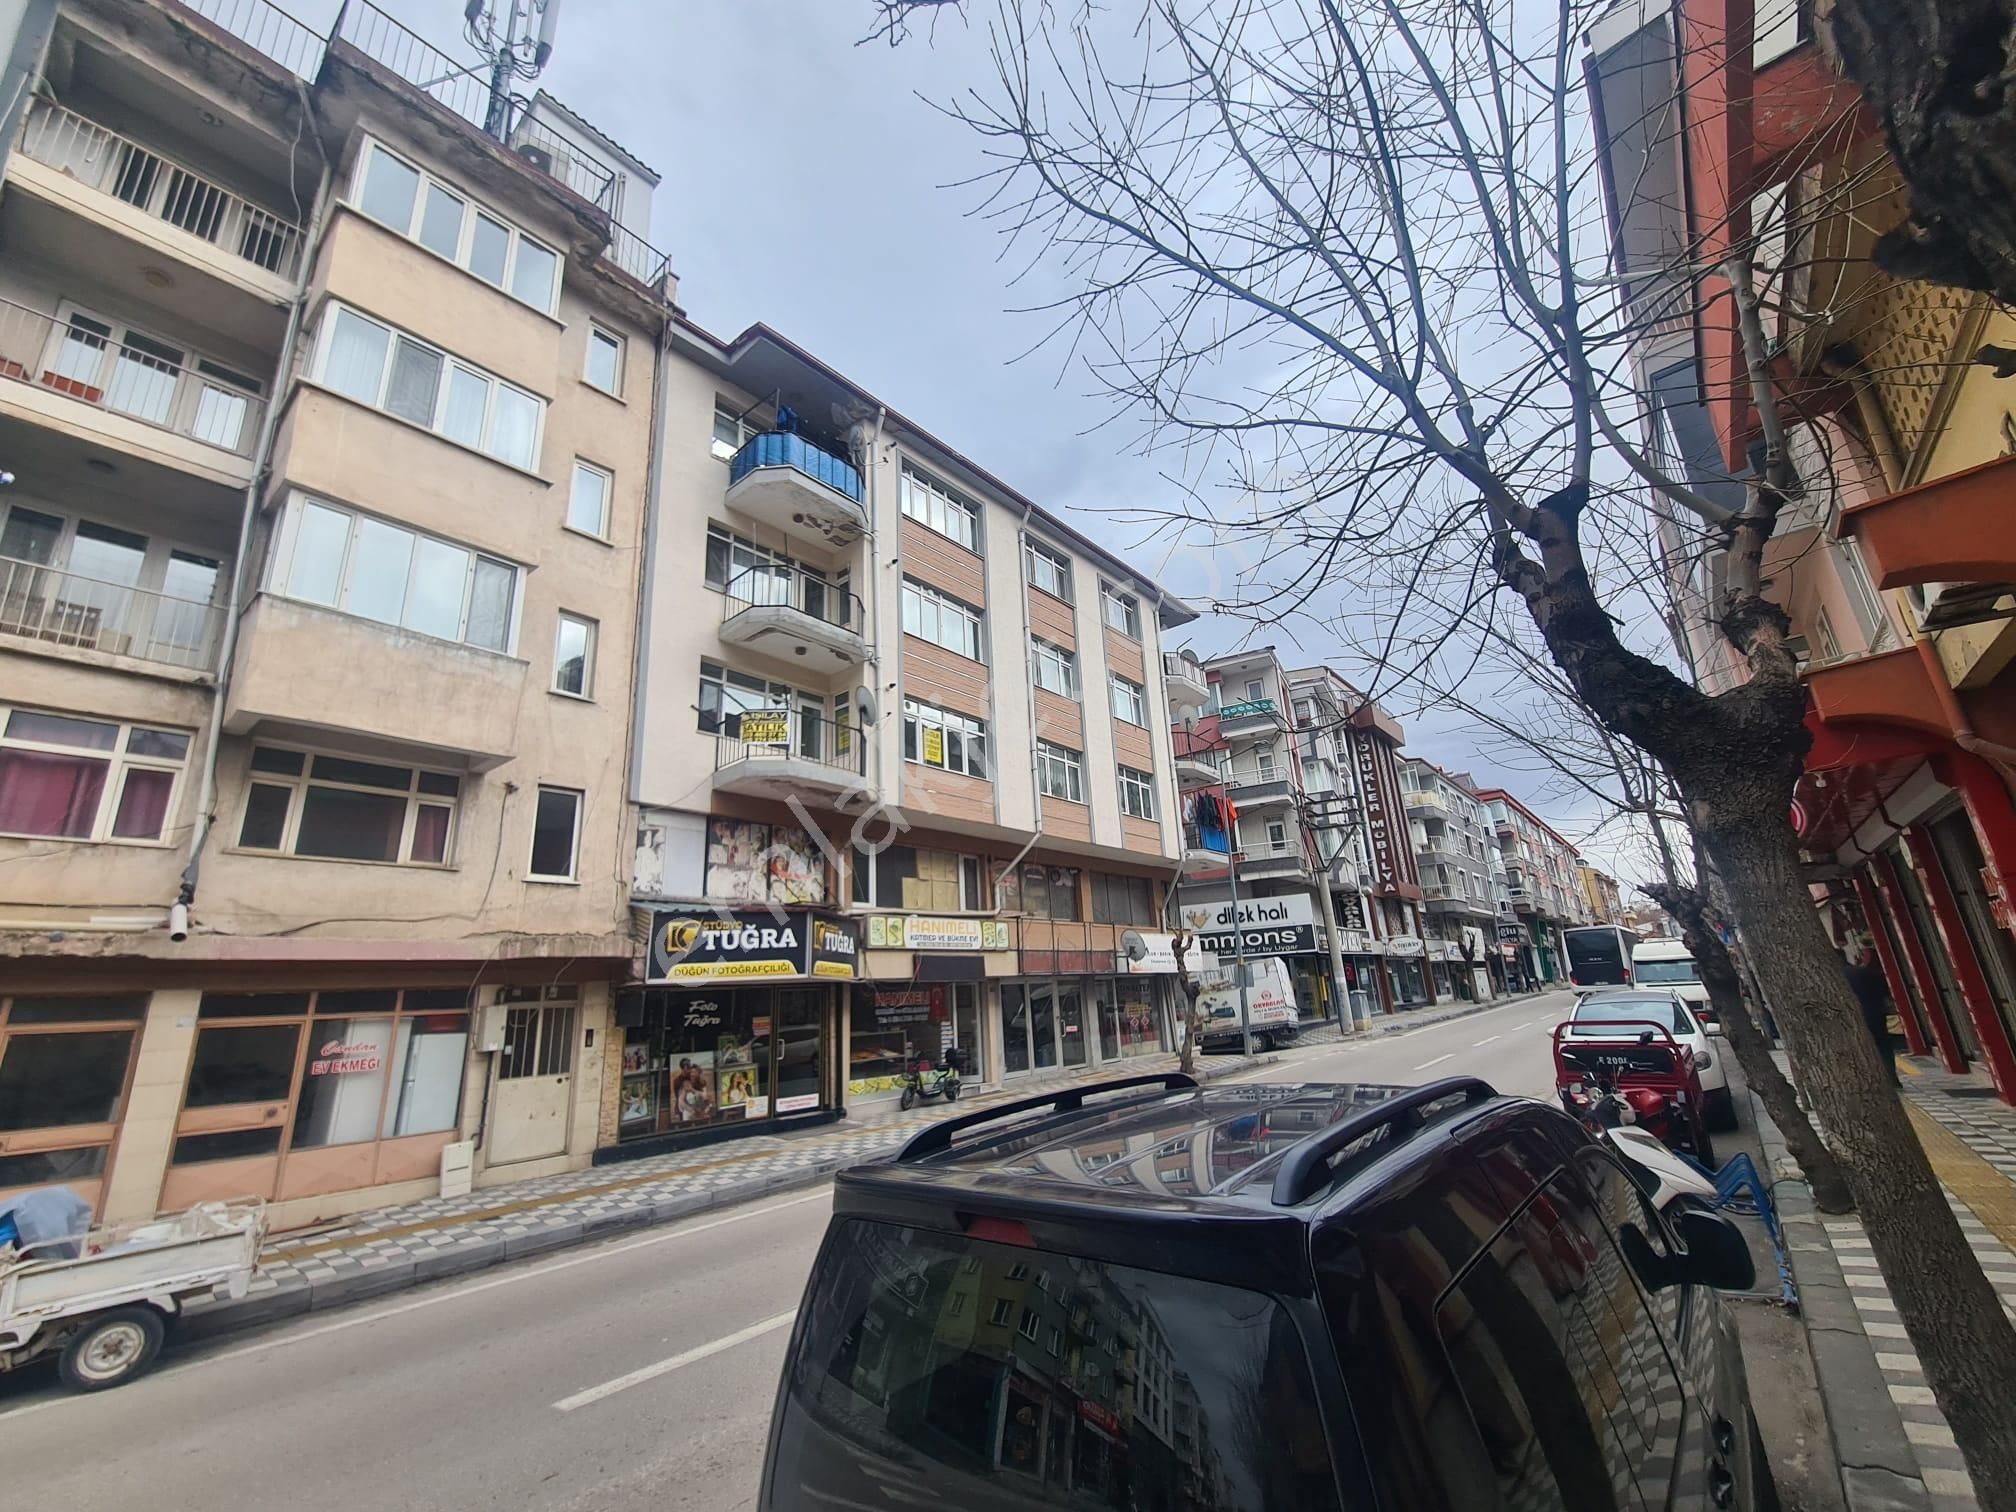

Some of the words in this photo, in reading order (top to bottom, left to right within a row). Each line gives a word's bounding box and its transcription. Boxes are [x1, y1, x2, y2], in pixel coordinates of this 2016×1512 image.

[702, 925, 798, 950] TUĞRA
[825, 931, 855, 954] TUĞRA
[674, 963, 710, 977] DÜĞÜN
[689, 999, 718, 1013] Foto
[312, 1060, 331, 1075] EV
